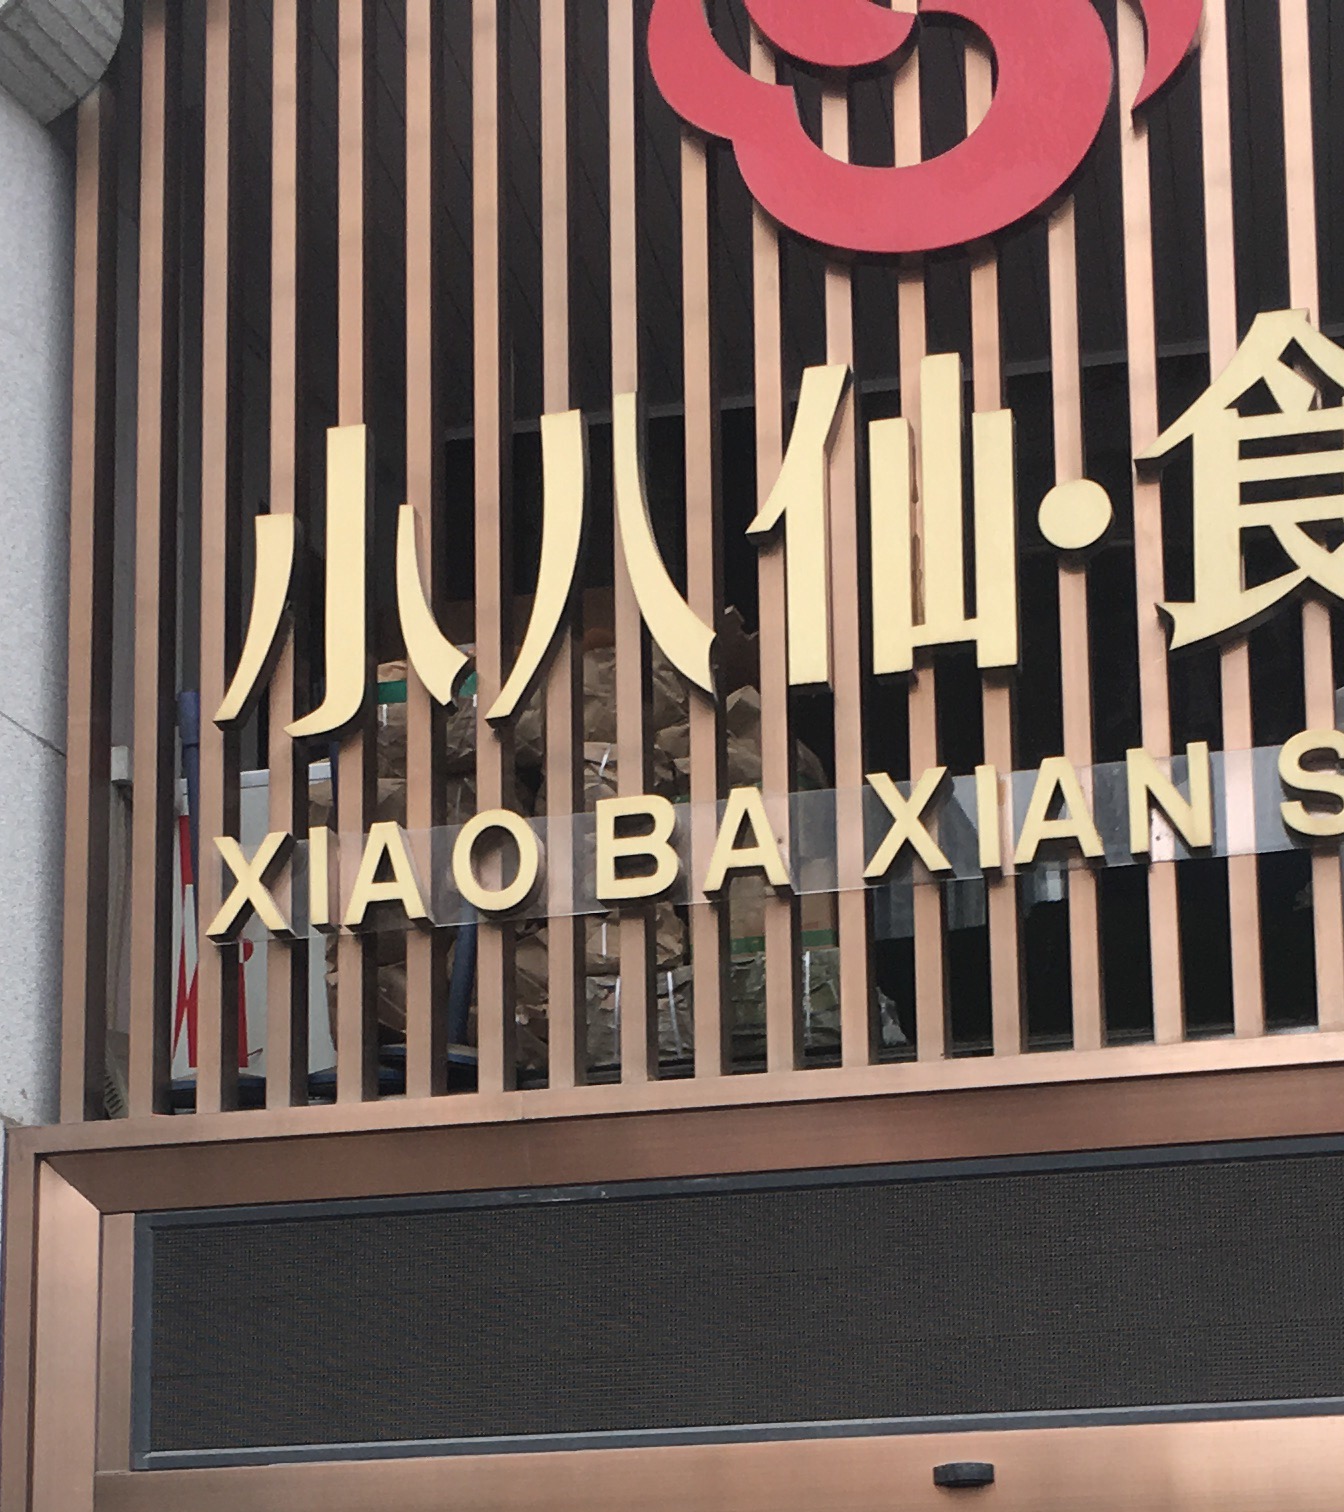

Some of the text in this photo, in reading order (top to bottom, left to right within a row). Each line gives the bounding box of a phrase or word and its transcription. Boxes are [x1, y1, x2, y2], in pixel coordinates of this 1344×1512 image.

[206, 809, 540, 940] XIAO
[596, 786, 794, 901] BA
[863, 741, 1212, 880] XIAN
